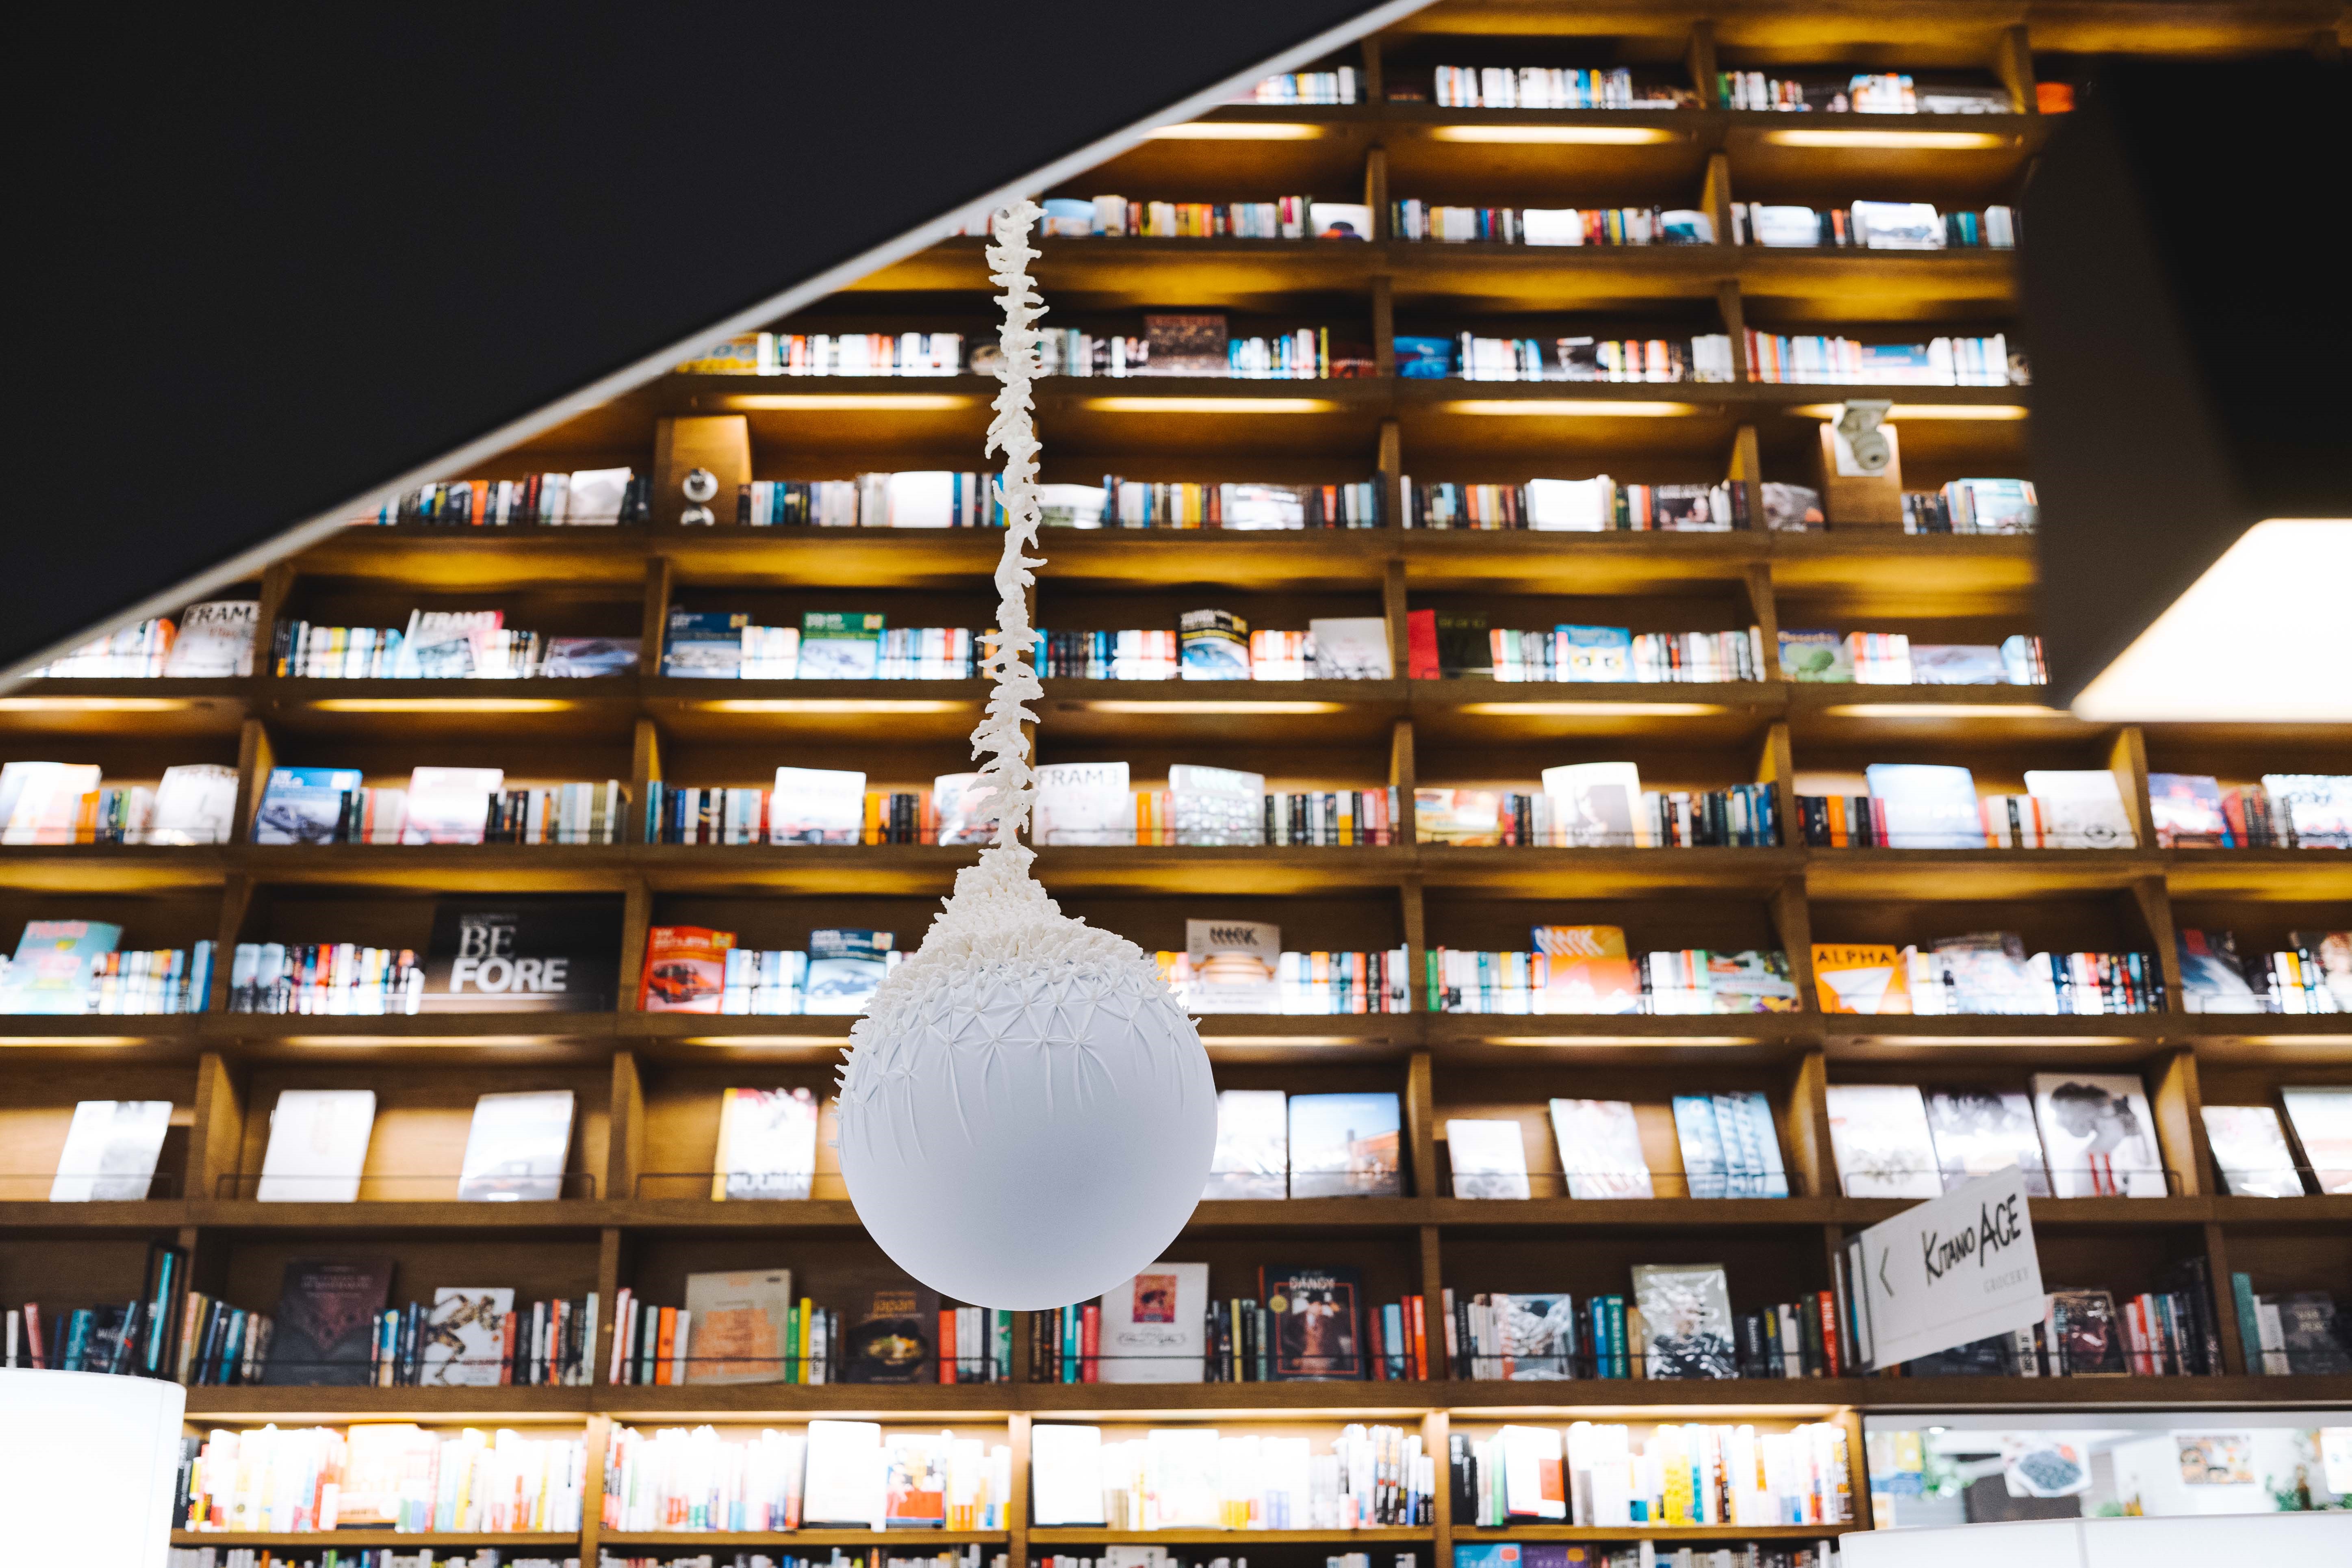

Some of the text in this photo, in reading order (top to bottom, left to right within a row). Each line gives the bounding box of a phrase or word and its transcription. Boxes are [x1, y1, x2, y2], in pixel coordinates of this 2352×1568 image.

[458, 924, 516, 958] BE
[1817, 950, 1892, 965] ALPHA
[449, 956, 569, 994] FORE
[1979, 1193, 2021, 1268] ACE
